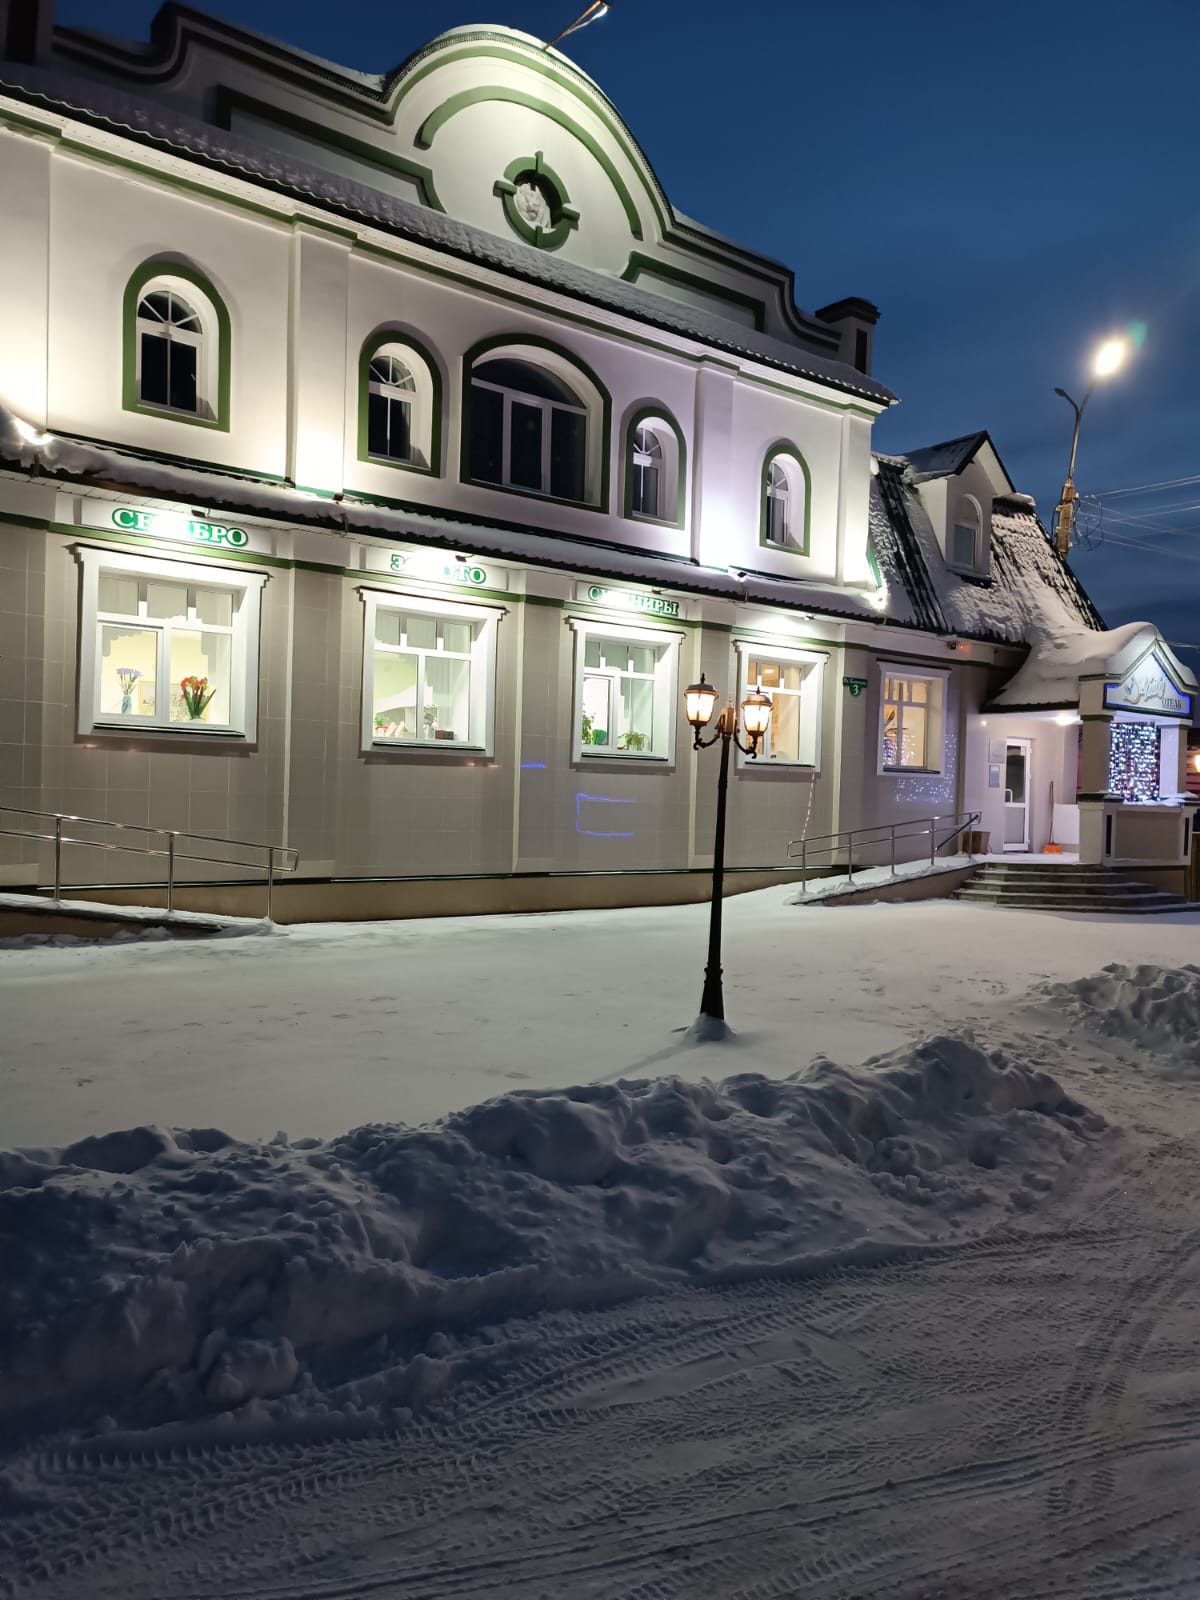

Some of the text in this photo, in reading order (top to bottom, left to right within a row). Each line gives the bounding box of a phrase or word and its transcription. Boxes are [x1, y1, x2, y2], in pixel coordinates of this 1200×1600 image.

[112, 507, 248, 547] СЕБРО
[588, 585, 679, 617] СНИРЫ
[852, 684, 859, 696] 3
